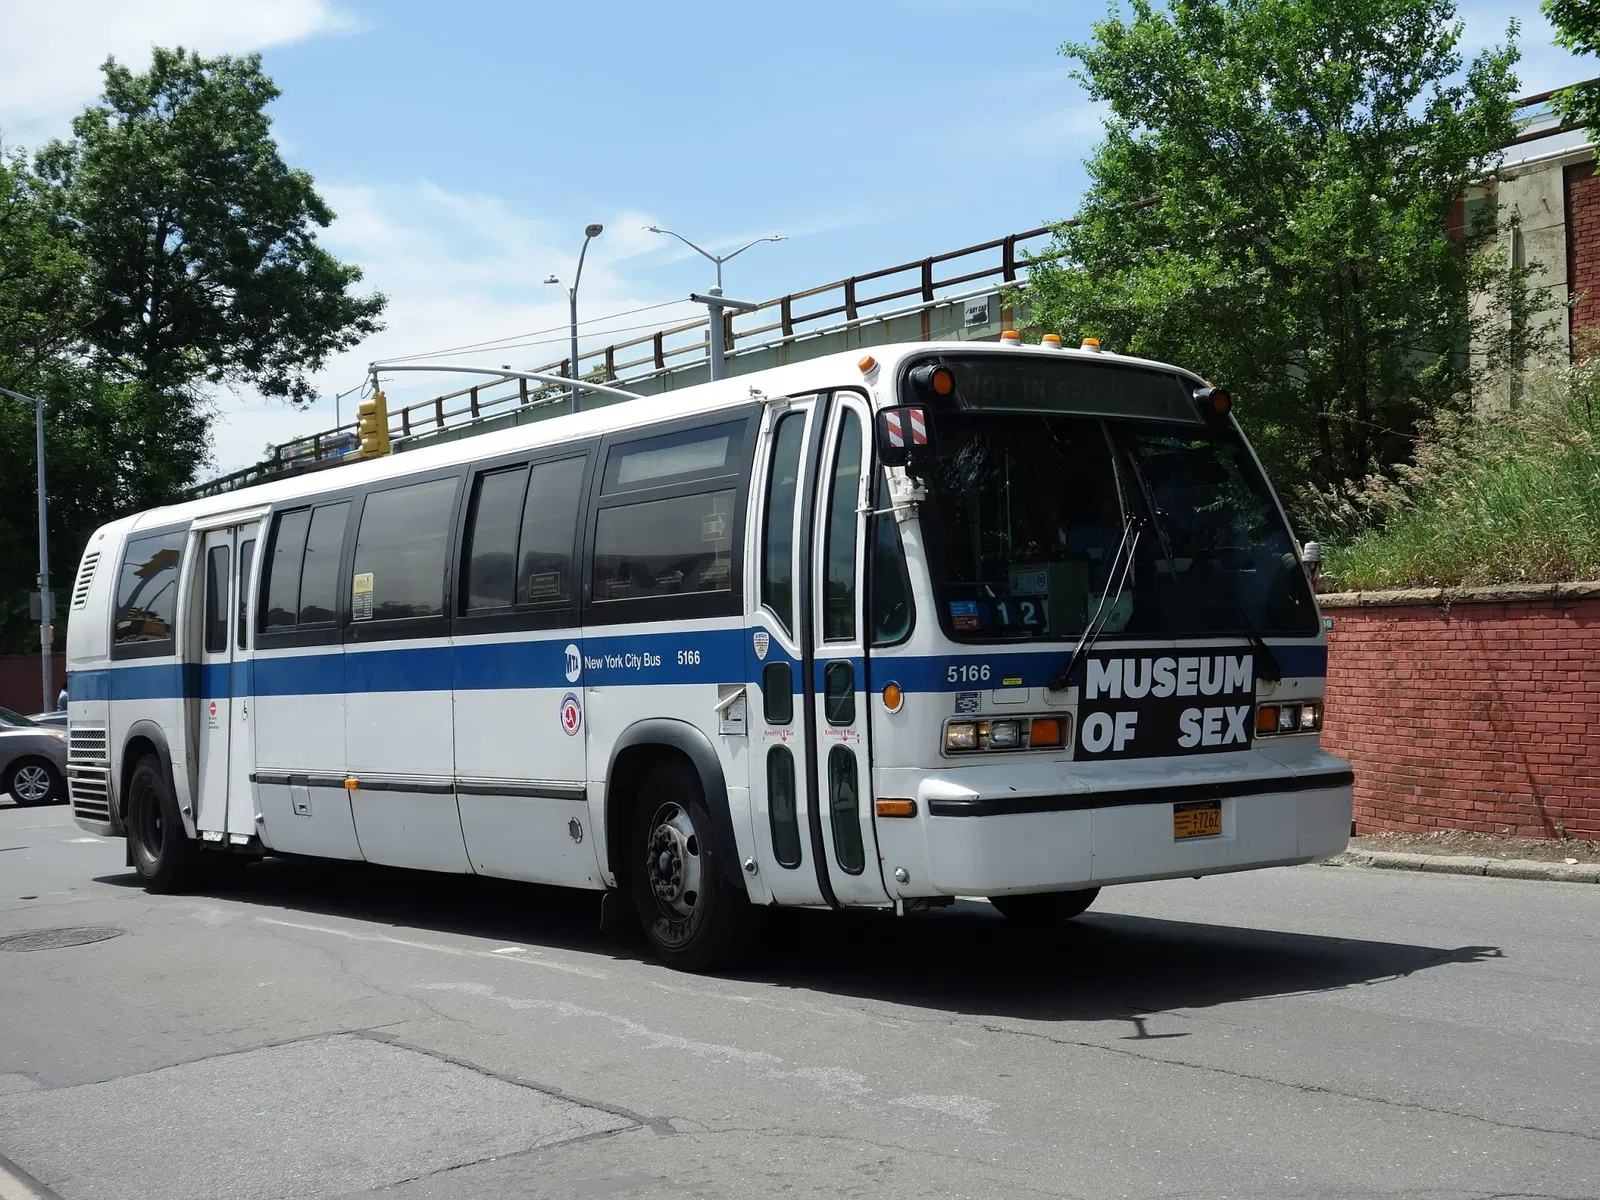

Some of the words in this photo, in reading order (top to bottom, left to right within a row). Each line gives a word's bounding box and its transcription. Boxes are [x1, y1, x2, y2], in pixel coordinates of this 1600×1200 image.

[967, 374, 1010, 398] NOT
[1021, 379, 1046, 403] IN
[584, 655, 603, 670] New
[604, 654, 623, 668] York
[624, 653, 642, 671] City
[643, 652, 661, 666] Bus
[677, 650, 700, 665] 5166
[947, 664, 991, 683] 5166
[1085, 655, 1253, 700] MUSEUM
[1081, 711, 1139, 753] OF
[1177, 705, 1251, 748] SEX
